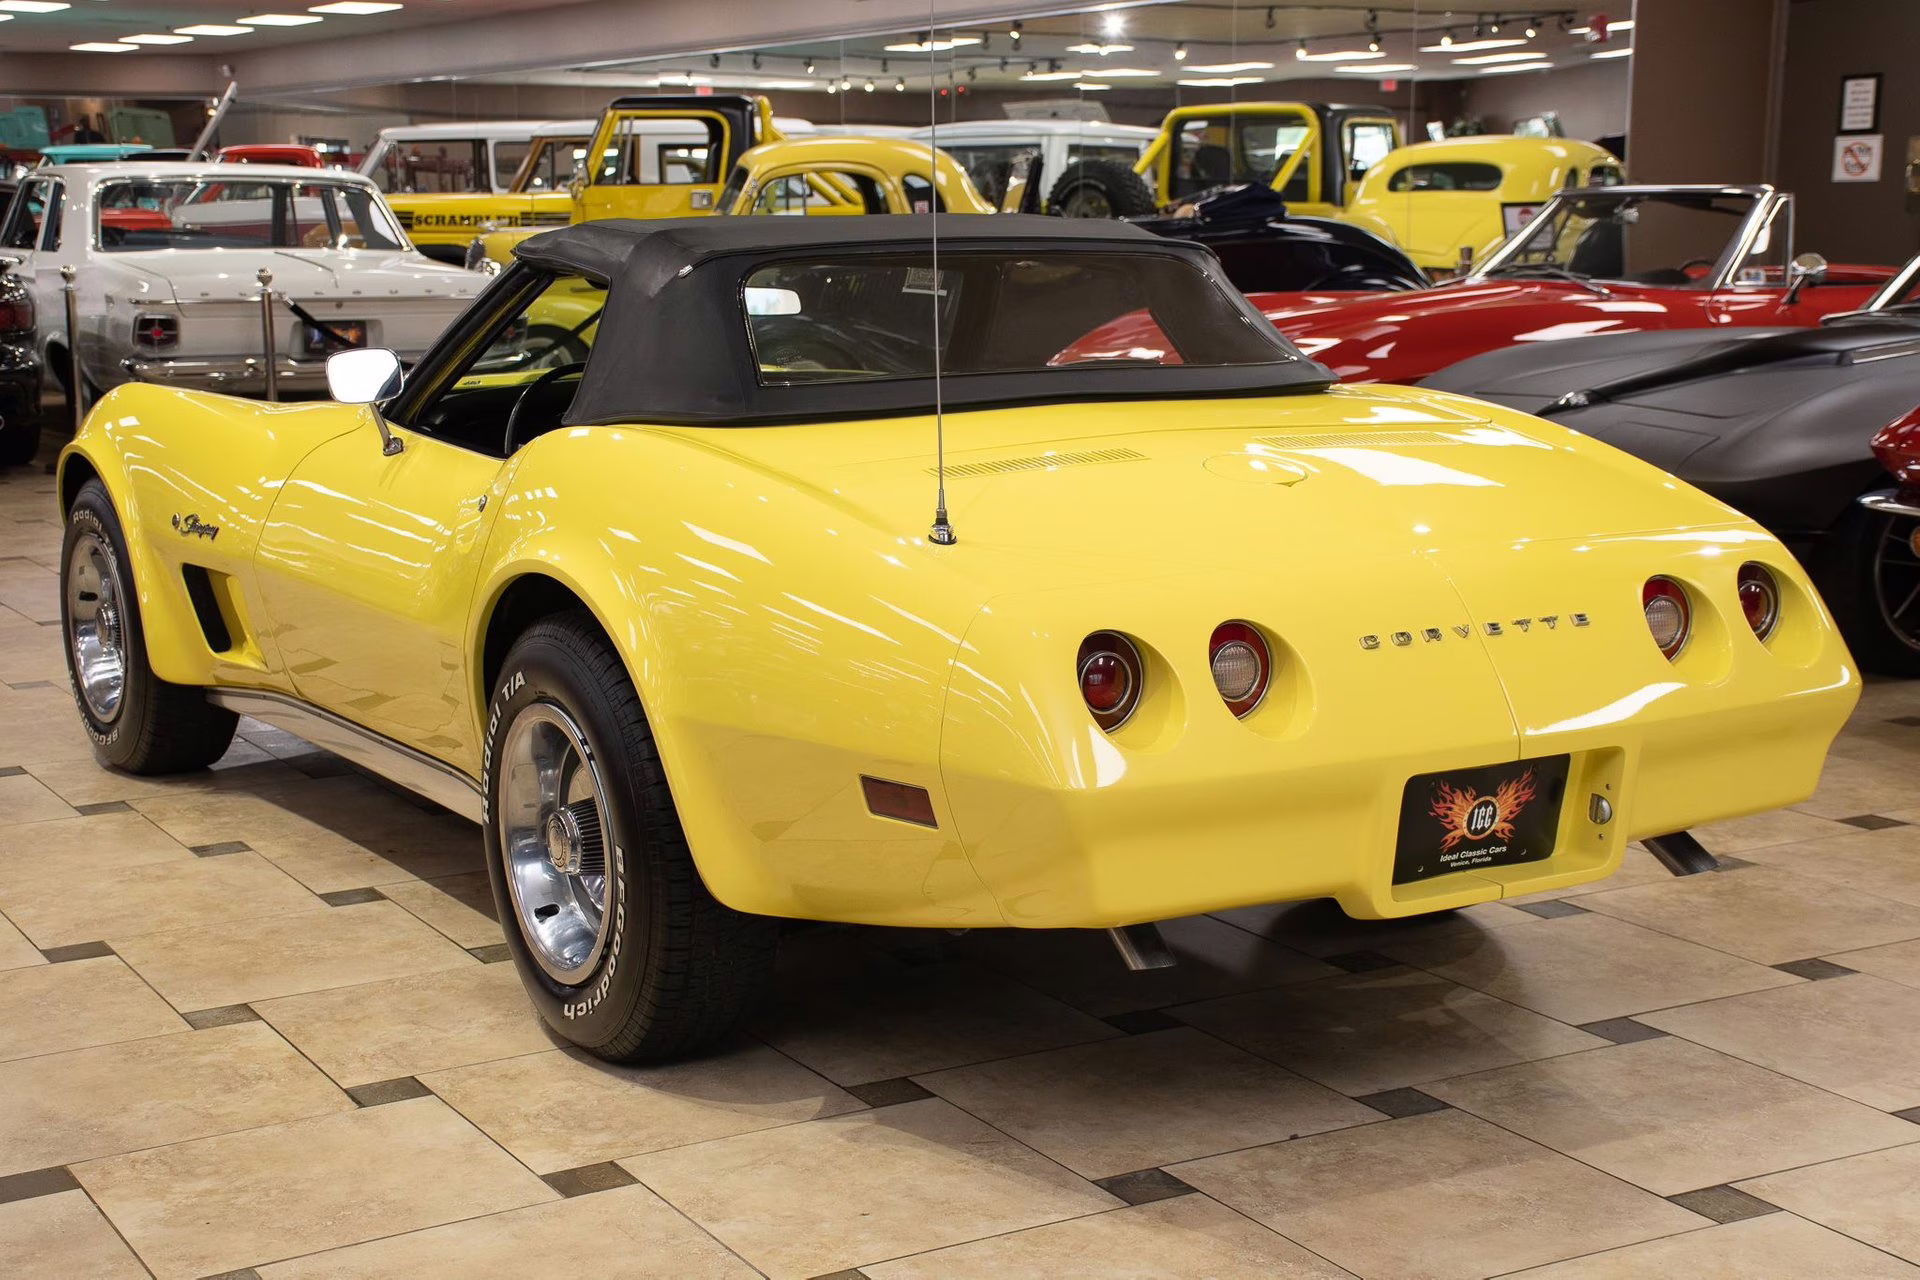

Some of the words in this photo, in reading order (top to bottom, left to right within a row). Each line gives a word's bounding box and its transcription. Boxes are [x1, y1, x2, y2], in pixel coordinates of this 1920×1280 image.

[73, 509, 102, 532] Radial
[1359, 612, 1590, 650] CORVETTE
[481, 703, 502, 824] Radial
[501, 670, 526, 701] T/A
[1471, 805, 1493, 831] ICC
[1440, 852, 1459, 862] Ideal
[1460, 849, 1488, 859] Classic
[1489, 845, 1507, 854] Cars
[1450, 860, 1470, 868] Venice,
[1471, 856, 1492, 864] Florida
[563, 845, 625, 1020] BFGoodrich
